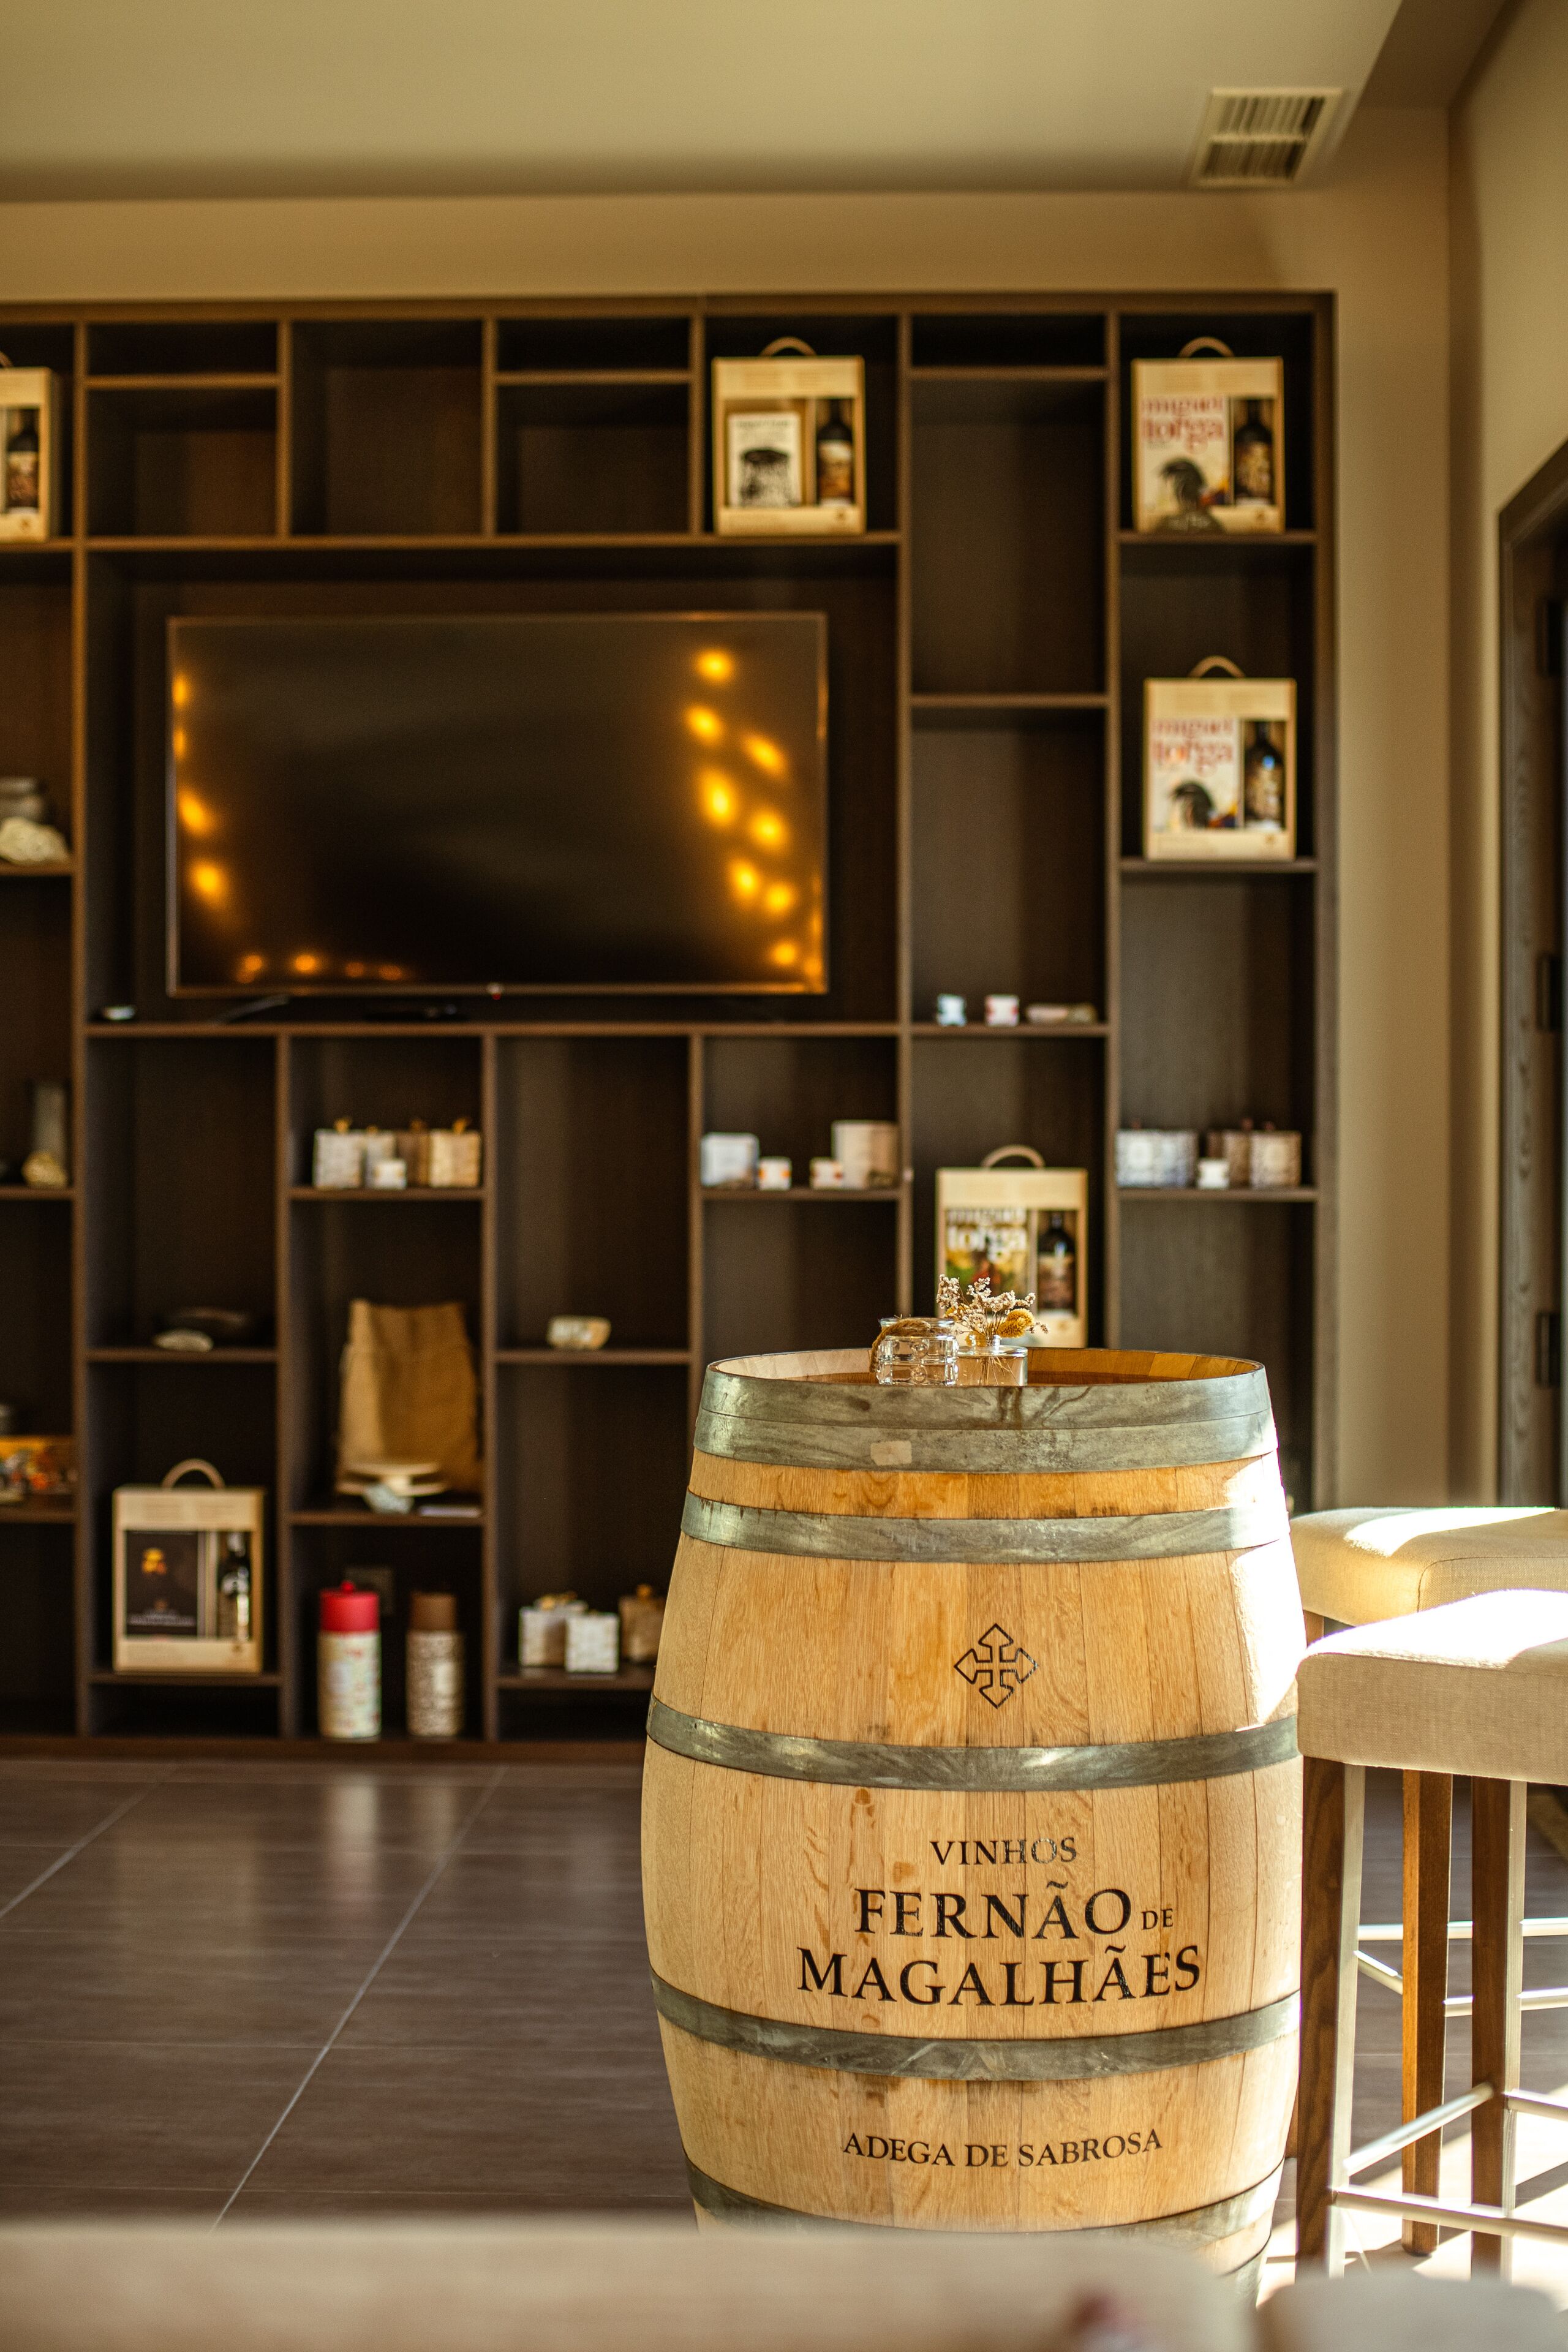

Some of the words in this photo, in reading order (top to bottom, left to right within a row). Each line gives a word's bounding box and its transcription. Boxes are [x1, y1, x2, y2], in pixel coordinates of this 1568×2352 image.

[930, 1838, 1078, 1865] VINHOS
[854, 1880, 1132, 1940] FERNÃO
[1141, 1908, 1174, 1931] DE
[796, 1945, 1200, 2007] MAGALHÃES
[843, 2133, 956, 2166] ADEGA
[965, 2144, 1009, 2168] DE
[1019, 2128, 1163, 2166] SABROSA
